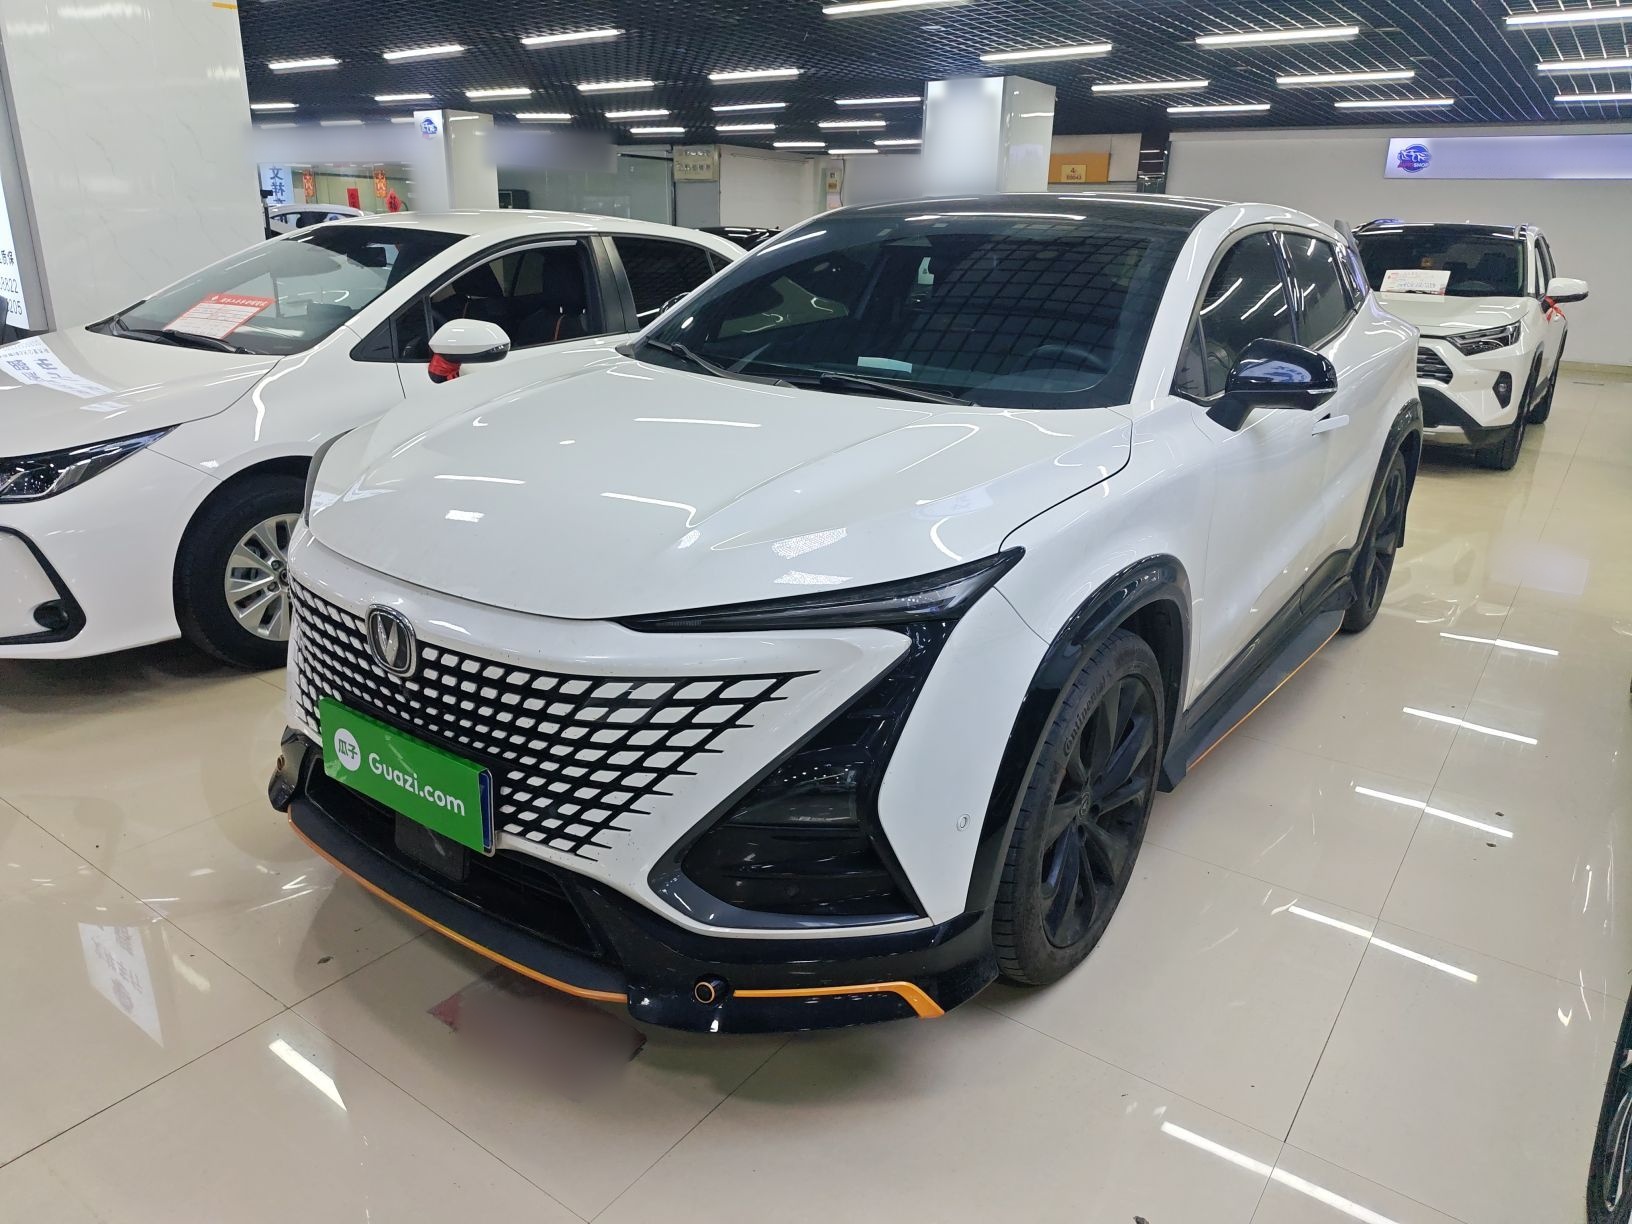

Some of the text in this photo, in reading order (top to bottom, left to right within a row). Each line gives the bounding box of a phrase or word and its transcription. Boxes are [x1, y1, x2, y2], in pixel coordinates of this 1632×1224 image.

[0, 249, 15, 266] 质保
[0, 276, 19, 294] 8822
[6, 297, 23, 316] 205
[337, 738, 358, 760] 瓜子
[368, 752, 466, 817] Guazi.com
